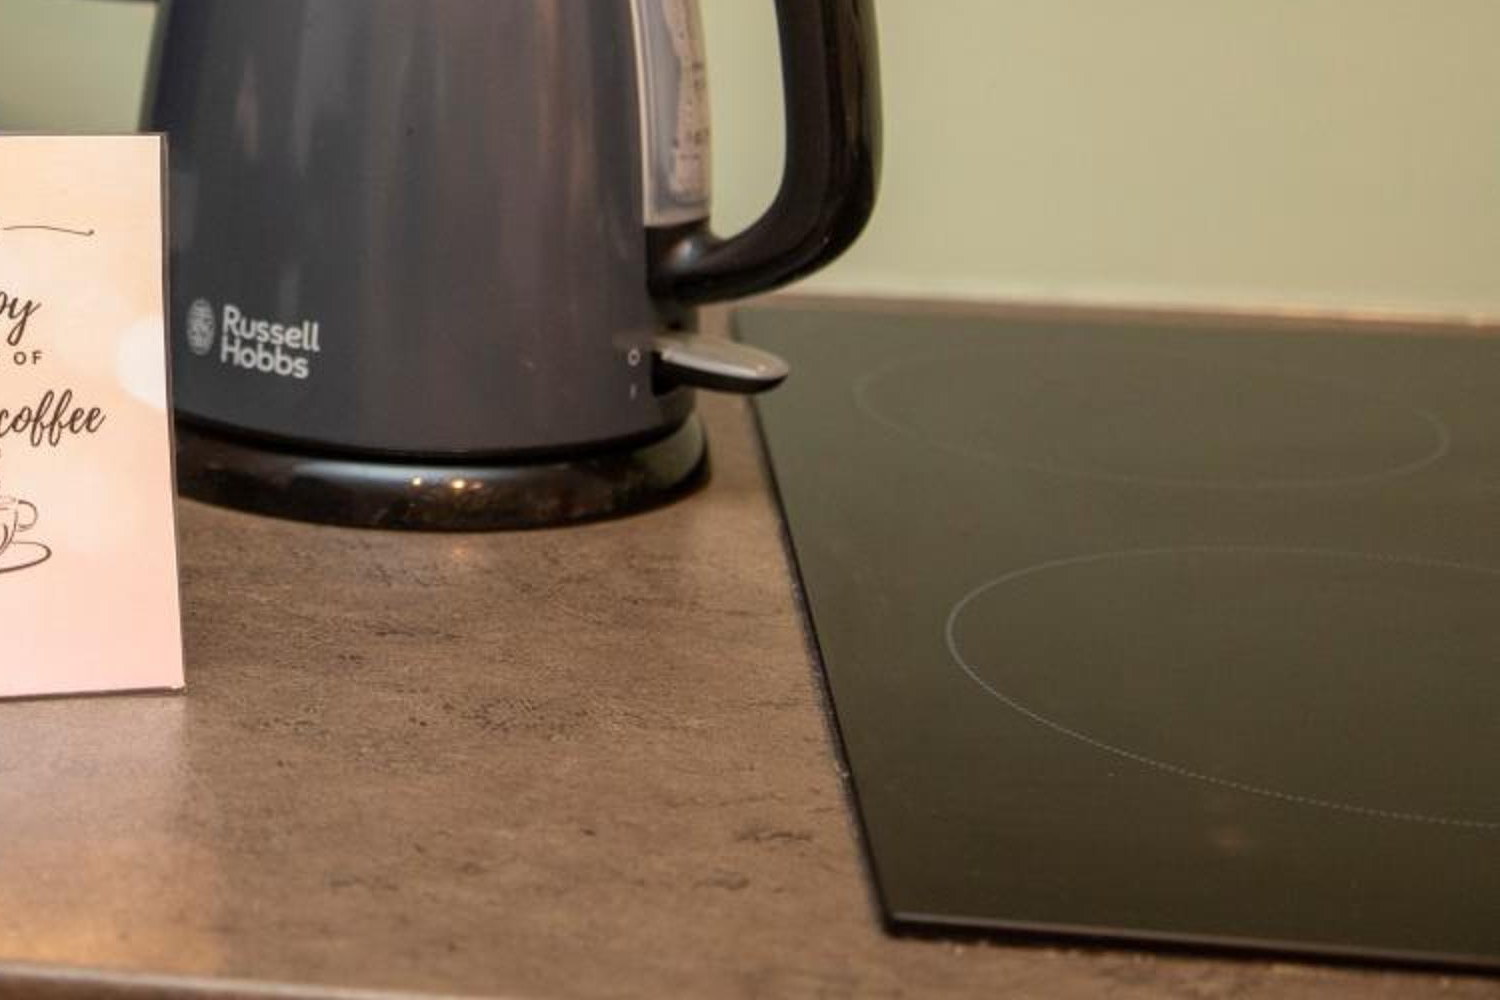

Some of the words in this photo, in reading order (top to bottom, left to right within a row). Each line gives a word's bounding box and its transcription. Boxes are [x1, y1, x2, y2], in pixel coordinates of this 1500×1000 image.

[222, 304, 320, 351] Russell
[13, 350, 43, 366] OF
[221, 334, 309, 379] Hobbs
